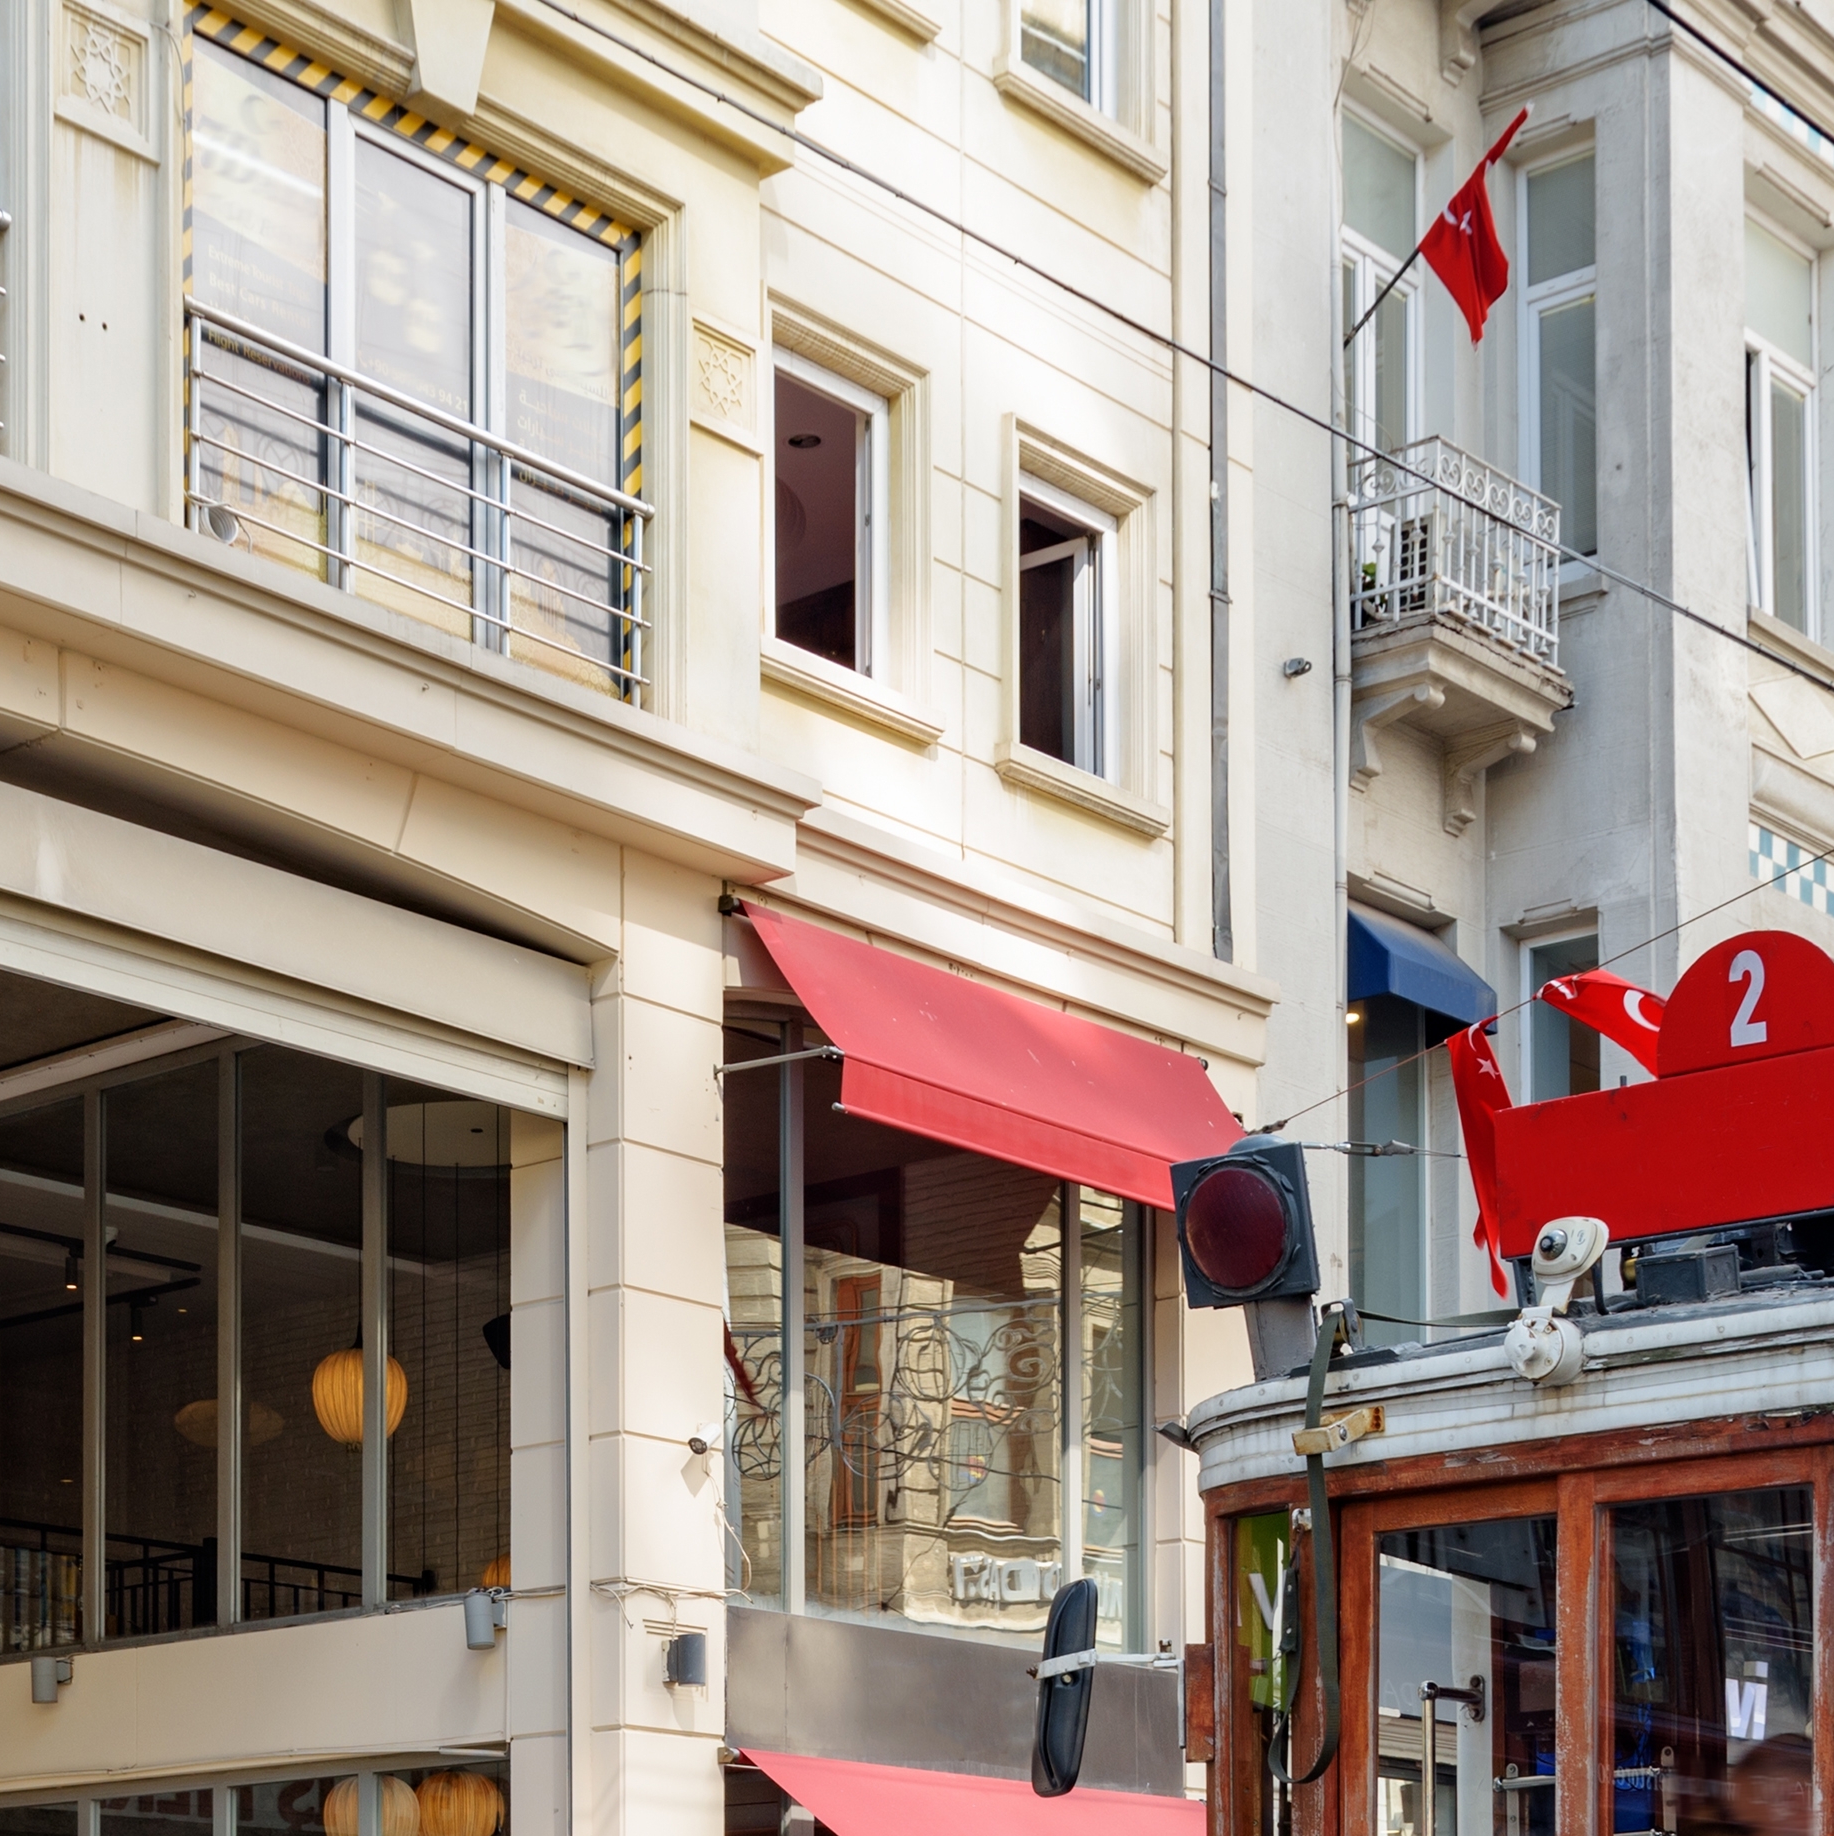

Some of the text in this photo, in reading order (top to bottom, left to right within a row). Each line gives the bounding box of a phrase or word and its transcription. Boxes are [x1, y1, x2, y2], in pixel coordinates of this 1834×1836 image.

[209, 272, 235, 296] Best
[240, 285, 267, 311] Cars
[208, 328, 312, 385] Flight Reservations
[1728, 949, 1768, 1048] 2
